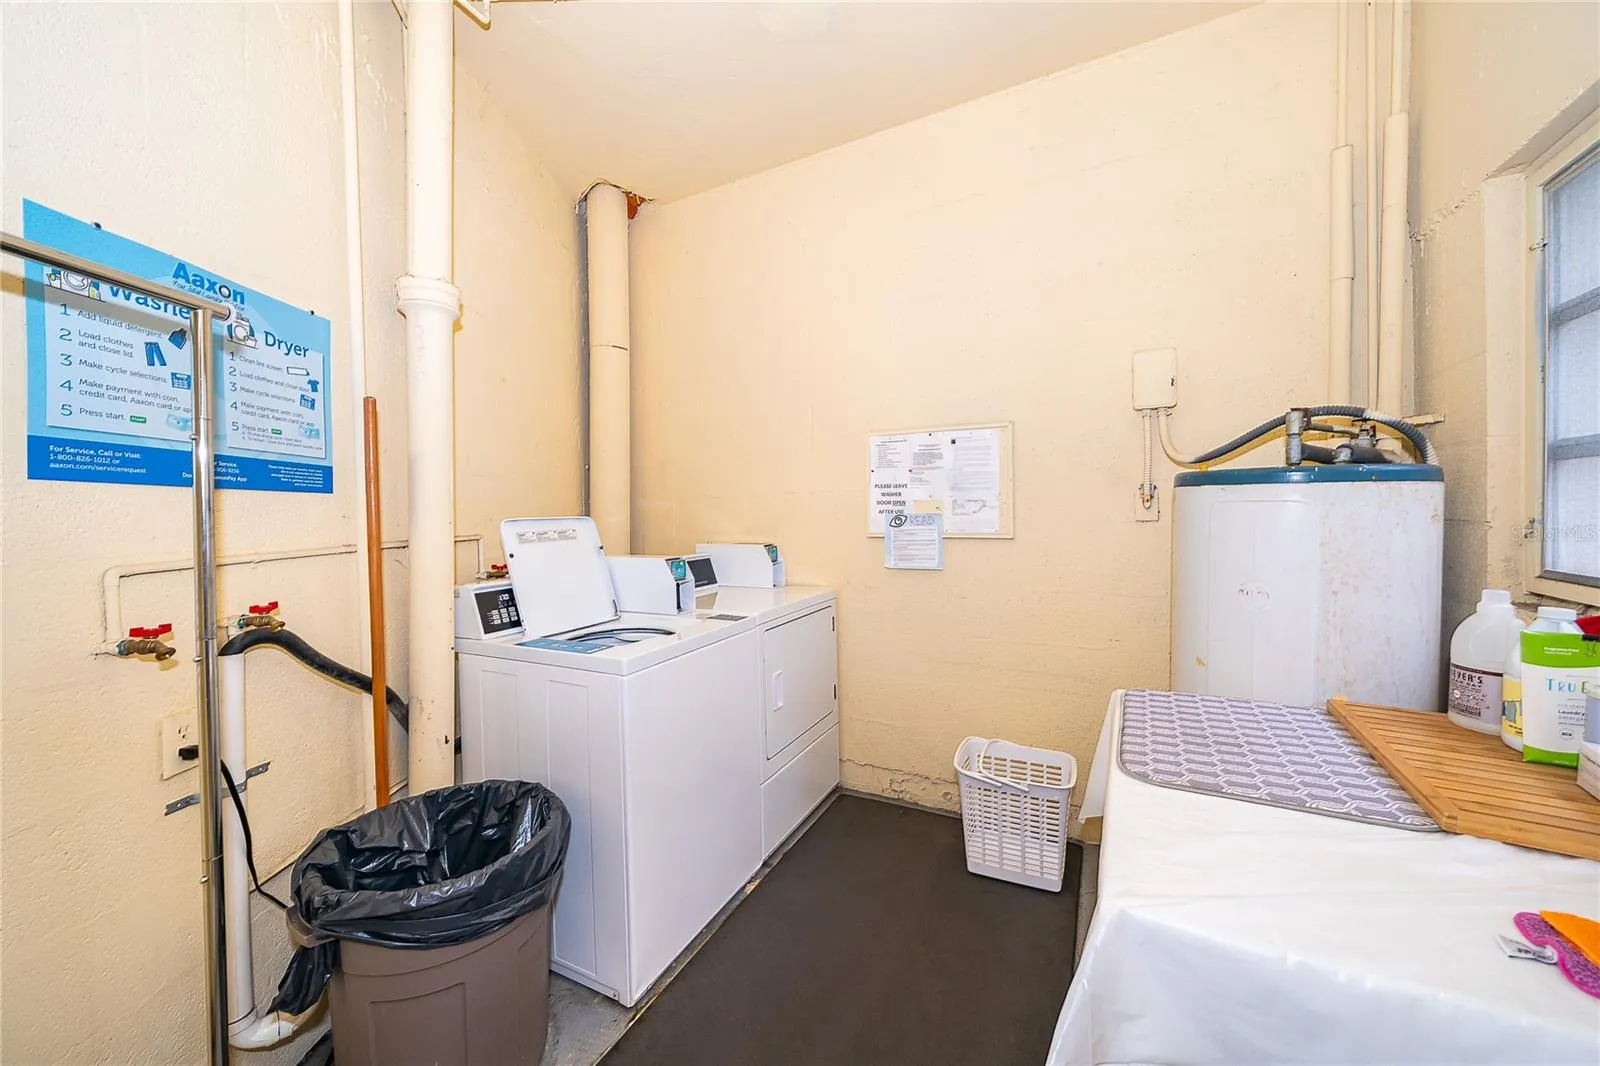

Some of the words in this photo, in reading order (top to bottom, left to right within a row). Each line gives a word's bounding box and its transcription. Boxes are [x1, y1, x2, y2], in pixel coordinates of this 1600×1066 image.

[172, 262, 245, 305] Aaxon
[109, 284, 191, 320] Washe
[60, 303, 70, 316] 1
[77, 310, 96, 321] Add
[99, 316, 123, 328] liquid
[59, 328, 72, 341] 2
[78, 329, 101, 341] Load
[103, 336, 134, 349] clothes
[264, 330, 309, 357] Dryer
[78, 341, 96, 351] and
[99, 345, 121, 355] close
[123, 348, 134, 358] lid.
[60, 353, 72, 366] 3
[79, 359, 103, 370] Make
[105, 364, 128, 376] cycle
[229, 352, 236, 361] 1
[239, 355, 255, 364] Clean
[255, 359, 265, 367] lint
[229, 366, 237, 377] 2
[239, 371, 253, 379] Load
[254, 375, 273, 384] clothes
[60, 379, 73, 391] 4
[79, 378, 103, 389] Make
[105, 383, 142, 397] payment
[144, 389, 160, 399] with
[229, 381, 237, 392] 3
[240, 386, 255, 394] Make
[256, 389, 269, 398] cycle
[79, 389, 105, 398] credit
[107, 393, 128, 403] card,
[130, 396, 155, 407] Aaxon
[156, 401, 172, 410] card
[230, 401, 238, 411] 4
[241, 401, 255, 409] Make
[256, 405, 279, 415] payment
[60, 404, 73, 417] 5
[80, 406, 103, 417] Press
[105, 410, 126, 420] start.
[241, 410, 256, 418] credit
[231, 421, 239, 431] 5
[242, 424, 256, 432] Press
[49, 453, 111, 464] 1-800-826-1012
[65, 446, 96, 456] Service,
[98, 449, 113, 457] Call
[125, 451, 141, 459] Visit:
[49, 463, 146, 474] aaxon.com/servicerequest
[910, 515, 935, 526] READ
